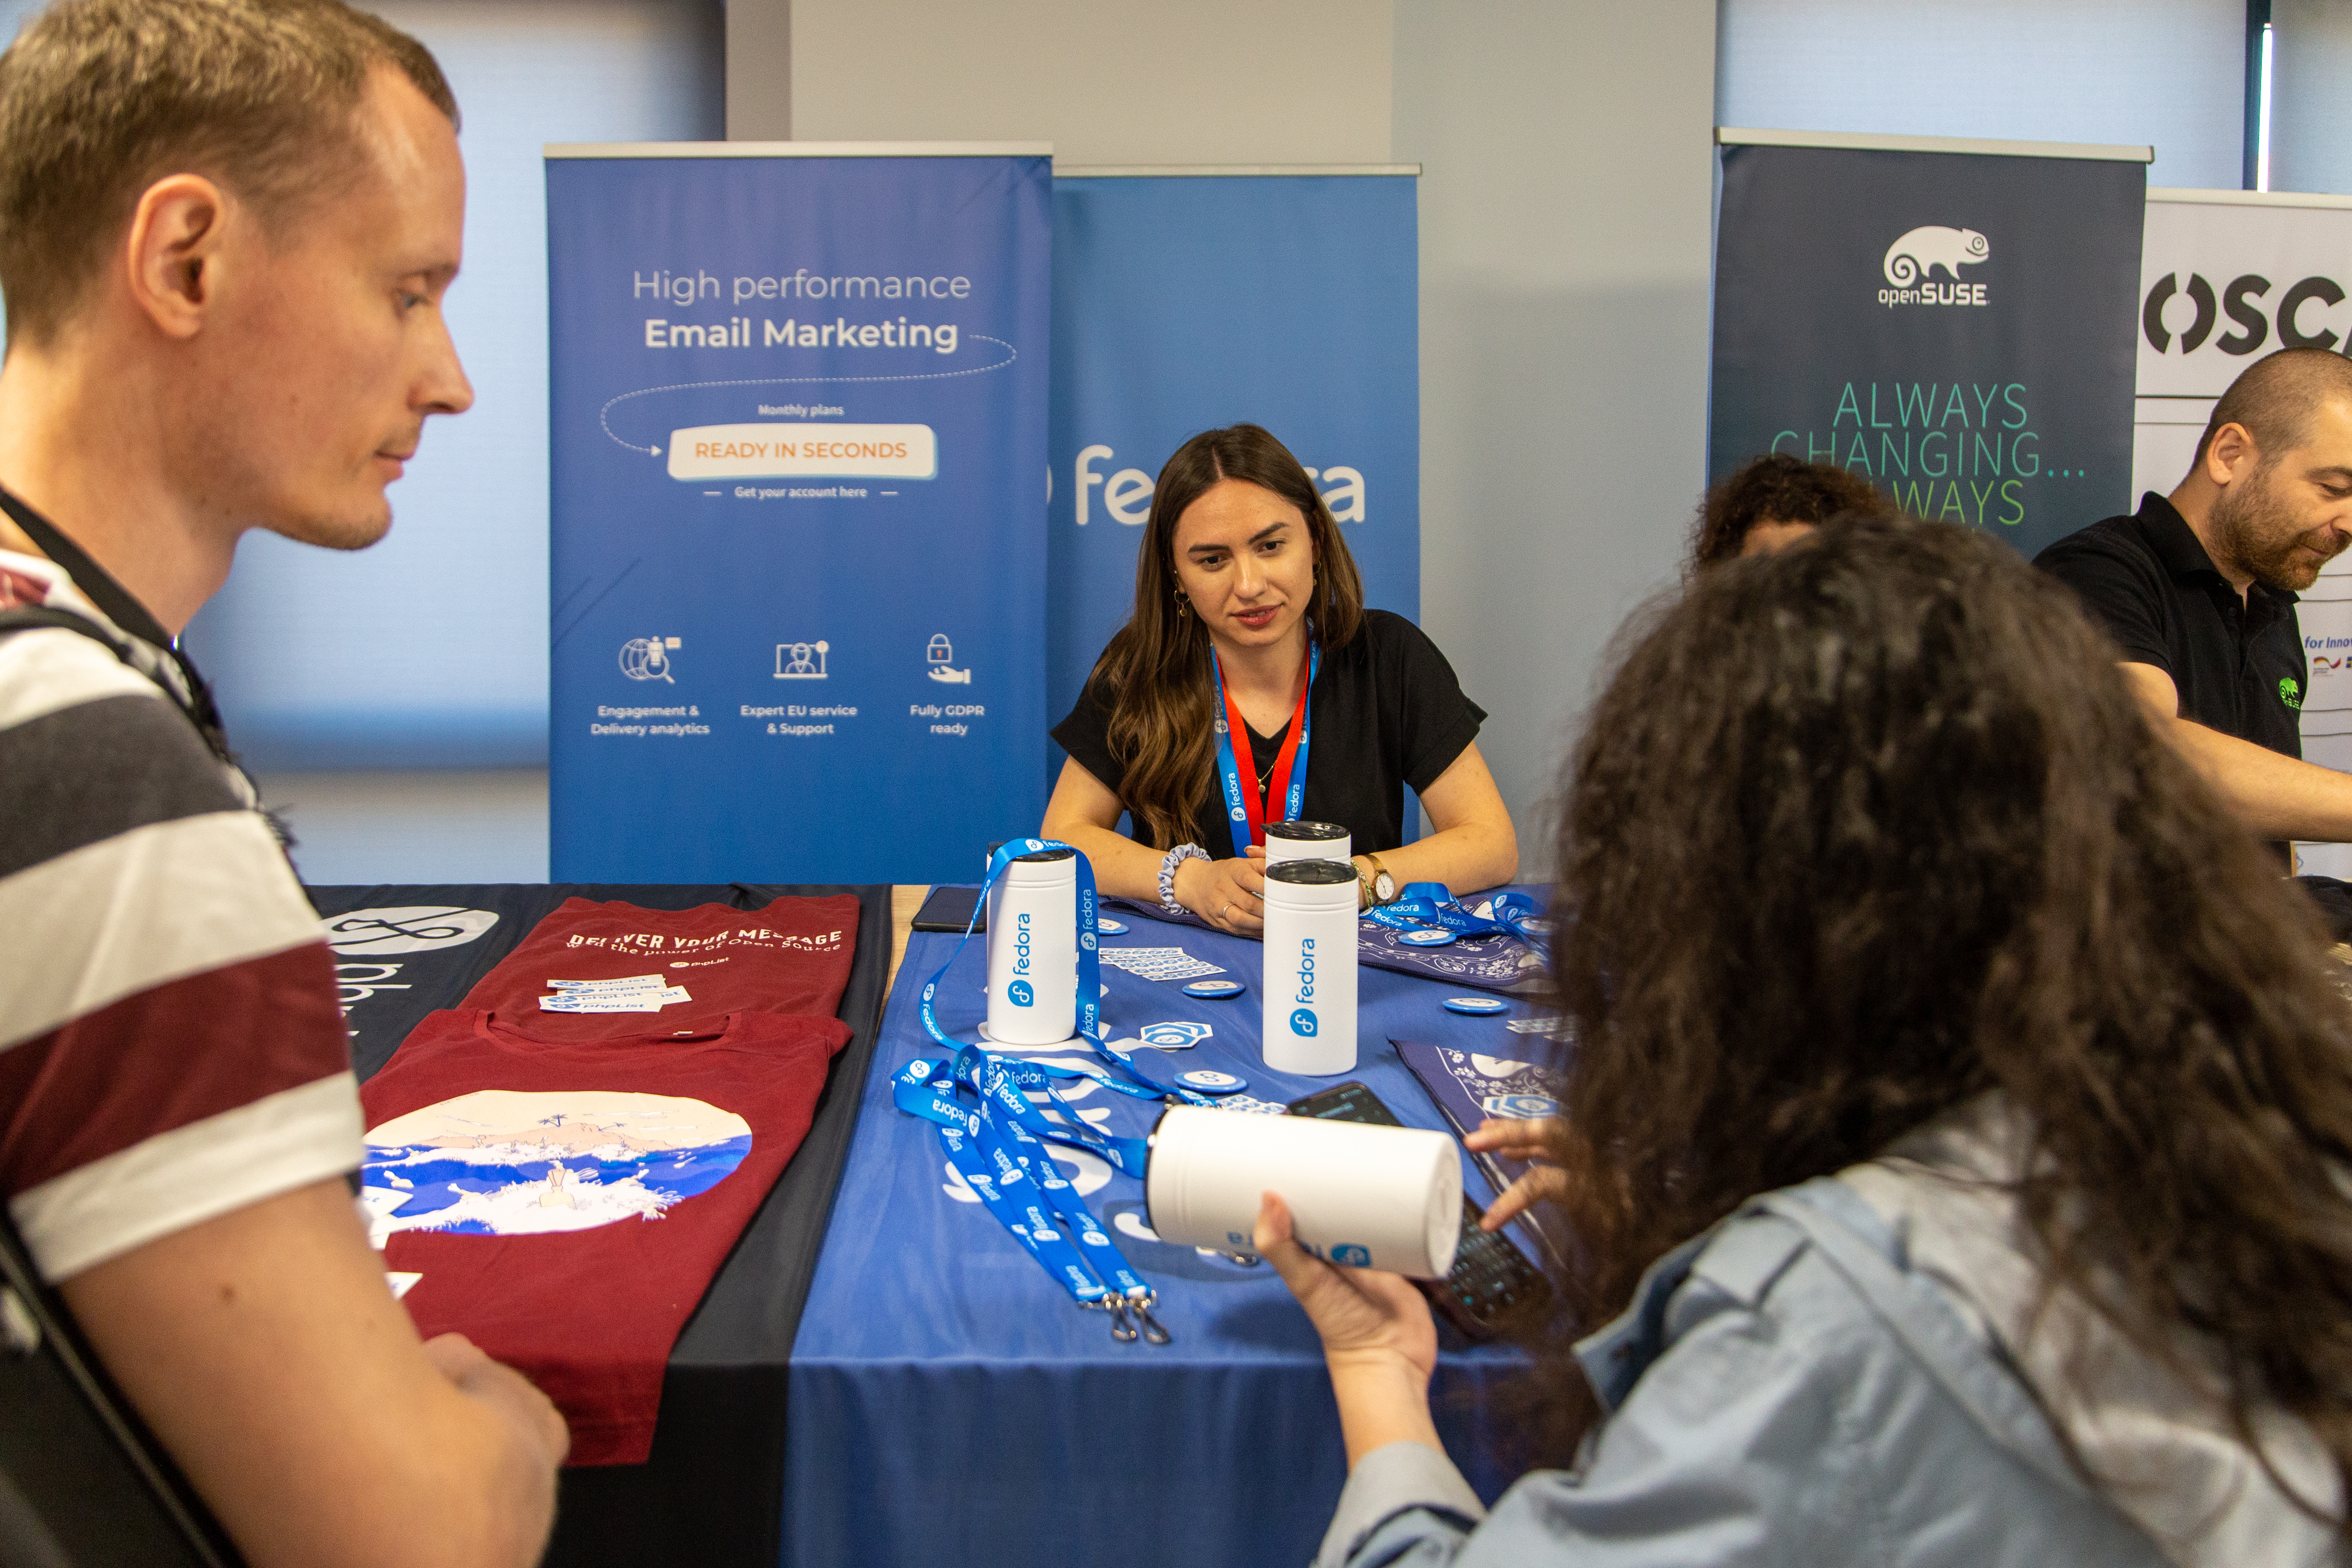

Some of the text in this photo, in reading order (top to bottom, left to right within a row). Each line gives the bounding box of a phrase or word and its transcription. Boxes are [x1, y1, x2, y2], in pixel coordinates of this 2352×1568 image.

[634, 268, 971, 306] High performance
[1878, 283, 1987, 309] openSUSE
[2143, 272, 2352, 356] OSC
[645, 316, 958, 354] Email Marketing
[758, 404, 844, 417] Monthly plans
[1833, 382, 2027, 429] ALWAYS
[695, 442, 907, 459] READY IN SECONDS
[735, 486, 867, 501] Get your account here
[1075, 444, 1365, 525] fea
[1870, 479, 2023, 525] WAYS
[2304, 636, 2324, 649] for
[598, 705, 699, 719] Engagement &
[740, 705, 858, 718] Expert EU service
[910, 704, 985, 718] Fully GDPR
[591, 723, 710, 737] Delivery analytics
[766, 723, 834, 736] & Support
[930, 723, 968, 736] ready
[1228, 772, 1241, 807] fedora
[1289, 784, 1300, 816] fedora
[1082, 889, 1093, 930] fedora
[1372, 909, 1403, 927] fedora
[1440, 913, 1467, 926] fedora
[611, 942, 638, 954] the
[705, 940, 726, 951] of
[729, 938, 774, 947] Open
[782, 940, 840, 952] Source
[674, 930, 729, 949] YOUR
[1013, 913, 1030, 976] fedora
[1295, 938, 1315, 1004] fedora
[923, 1004, 943, 1041] fedora
[956, 1056, 971, 1080] dora
[997, 1083, 1026, 1115] fedora
[932, 1099, 968, 1127] fedora
